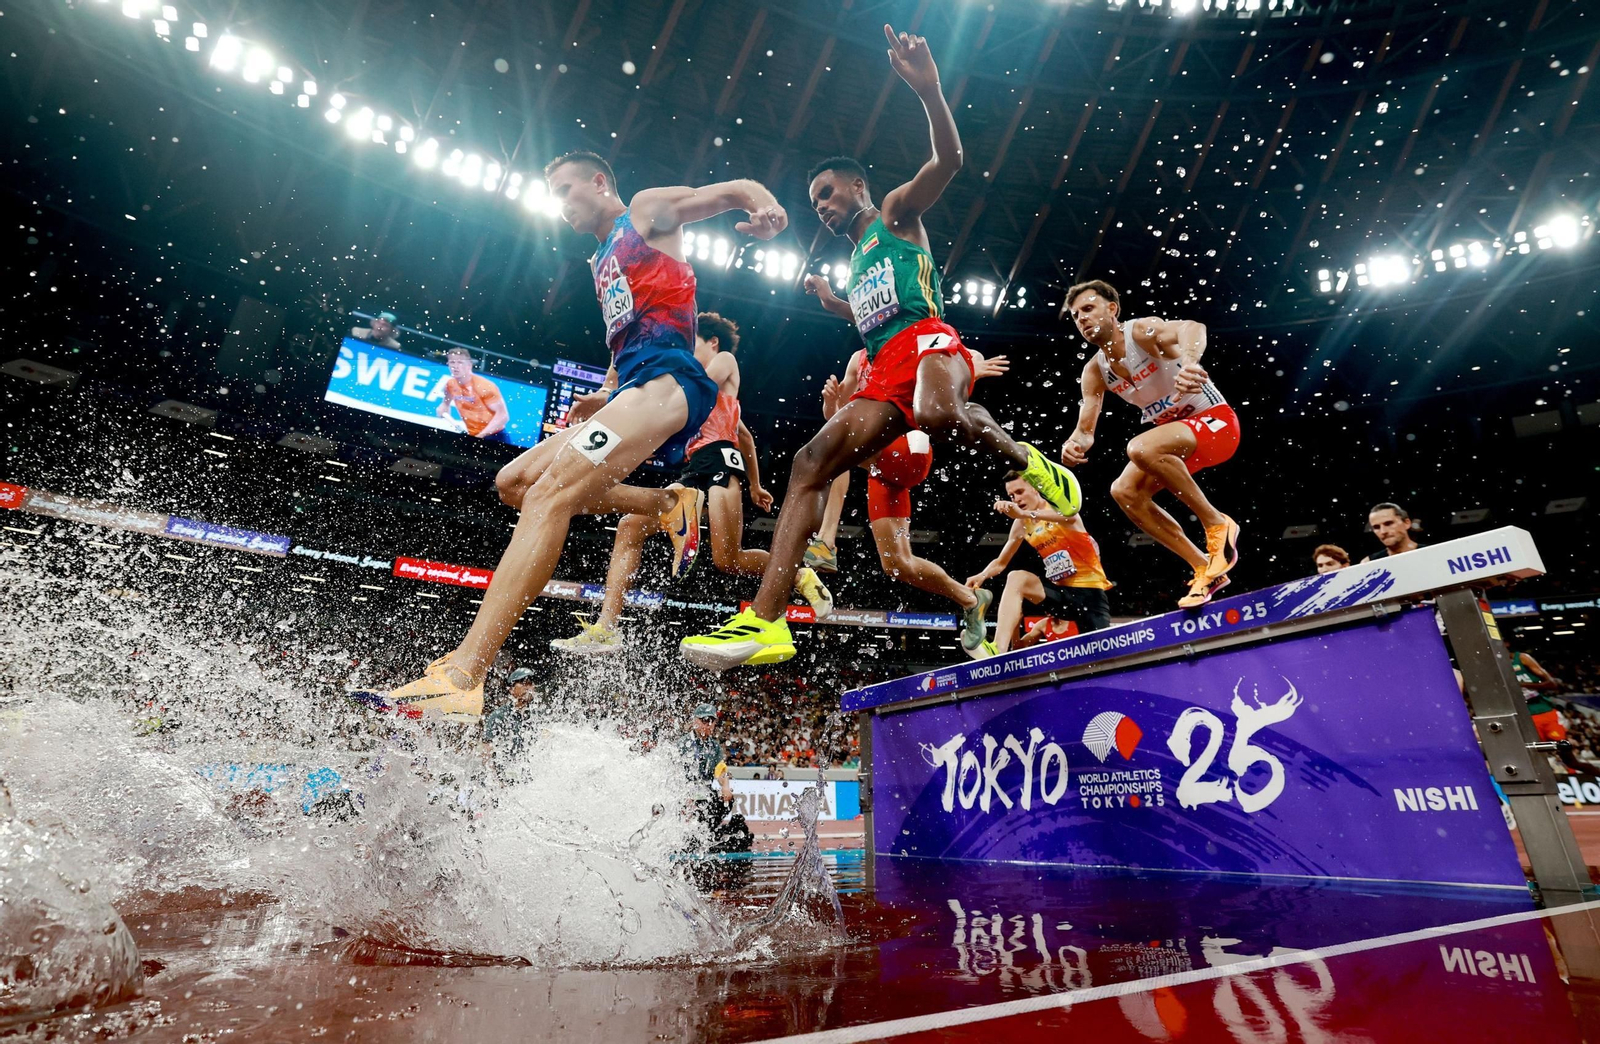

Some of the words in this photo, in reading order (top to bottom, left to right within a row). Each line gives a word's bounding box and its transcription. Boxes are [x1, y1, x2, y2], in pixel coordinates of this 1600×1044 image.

[854, 270, 888, 299] TDK
[885, 307, 898, 318] 25
[1144, 395, 1174, 419] TDK
[581, 430, 608, 451] 9
[730, 452, 739, 466] 6
[1047, 551, 1066, 563] TDK
[1447, 546, 1512, 575] NISHI
[970, 665, 1001, 680] WORLD
[1004, 651, 1056, 674] ATHLETICS
[1058, 628, 1155, 661] CHAMPIONSHIPS
[1241, 602, 1267, 621] 25
[918, 727, 1069, 813] TOKYO
[1167, 675, 1303, 813] 25
[1078, 773, 1109, 784] WORLD
[1111, 769, 1161, 782] ATHLETICS
[1080, 781, 1162, 796] CHAMPIONSHIPS
[1393, 786, 1479, 812] NISHI
[1144, 794, 1165, 807] 25
